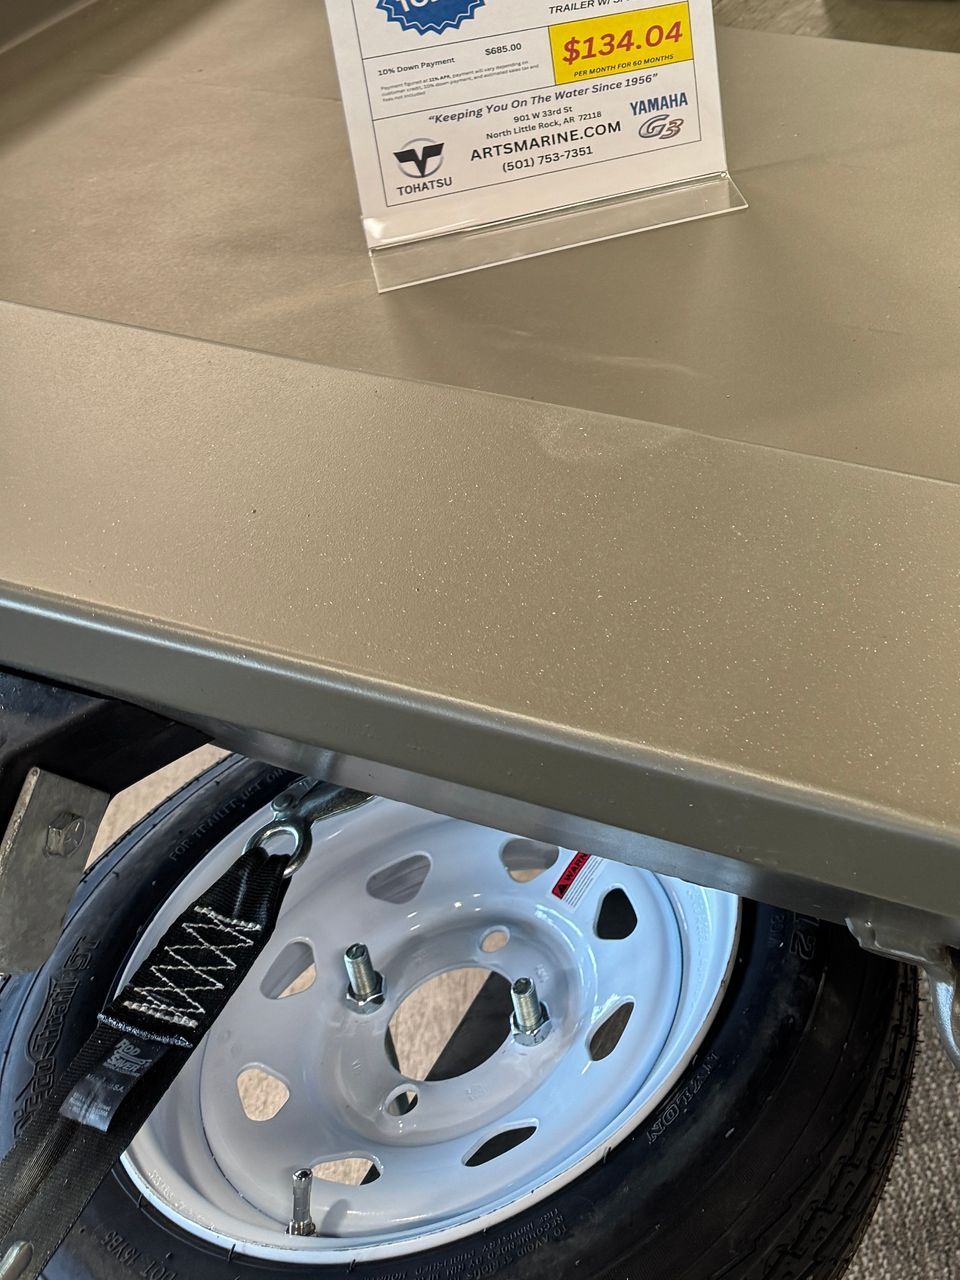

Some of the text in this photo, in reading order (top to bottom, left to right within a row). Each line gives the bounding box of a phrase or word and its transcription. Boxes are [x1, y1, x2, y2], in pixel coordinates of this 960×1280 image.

[549, 0, 595, 15] TRAILER
[485, 43, 522, 56] $685.00
[562, 21, 683, 66] $134.04
[378, 57, 455, 76] 10% Down Payment
[589, 65, 617, 74] MONTH
[617, 62, 632, 70] FOR
[643, 54, 674, 65] MONTHS
[486, 102, 509, 114] You
[511, 98, 528, 109] On
[530, 93, 552, 106] The
[554, 86, 589, 101] Water
[591, 80, 622, 95] Since
[630, 91, 689, 116] YAMAHA
[513, 106, 573, 123] 901 W 33rd St
[486, 111, 602, 140] North Little Rock, AR 72118
[638, 114, 685, 140] G3
[470, 121, 622, 161] ARTSMARINE.COM
[502, 146, 594, 173] (501) 753-7351
[396, 177, 453, 196] TOHATSU
[115, 1038, 141, 1056] ROD
[106, 1055, 141, 1073] SAVER
